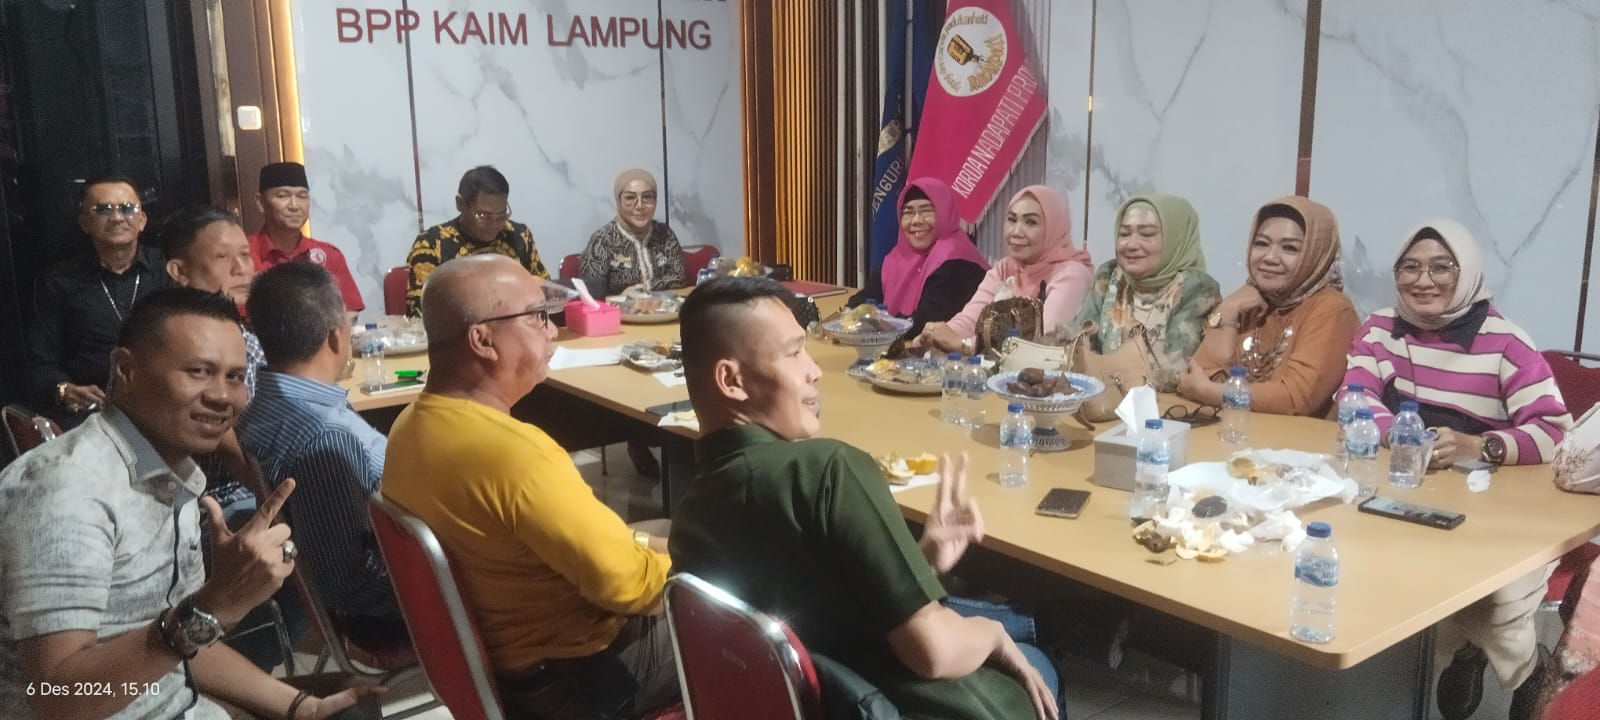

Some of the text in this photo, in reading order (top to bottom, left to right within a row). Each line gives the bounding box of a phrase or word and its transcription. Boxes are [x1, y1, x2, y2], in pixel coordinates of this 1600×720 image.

[336, 7, 712, 50] BPP KAIM LAMPUNG
[951, 156, 988, 200] KORDA
[970, 96, 1025, 165] NADAPATI
